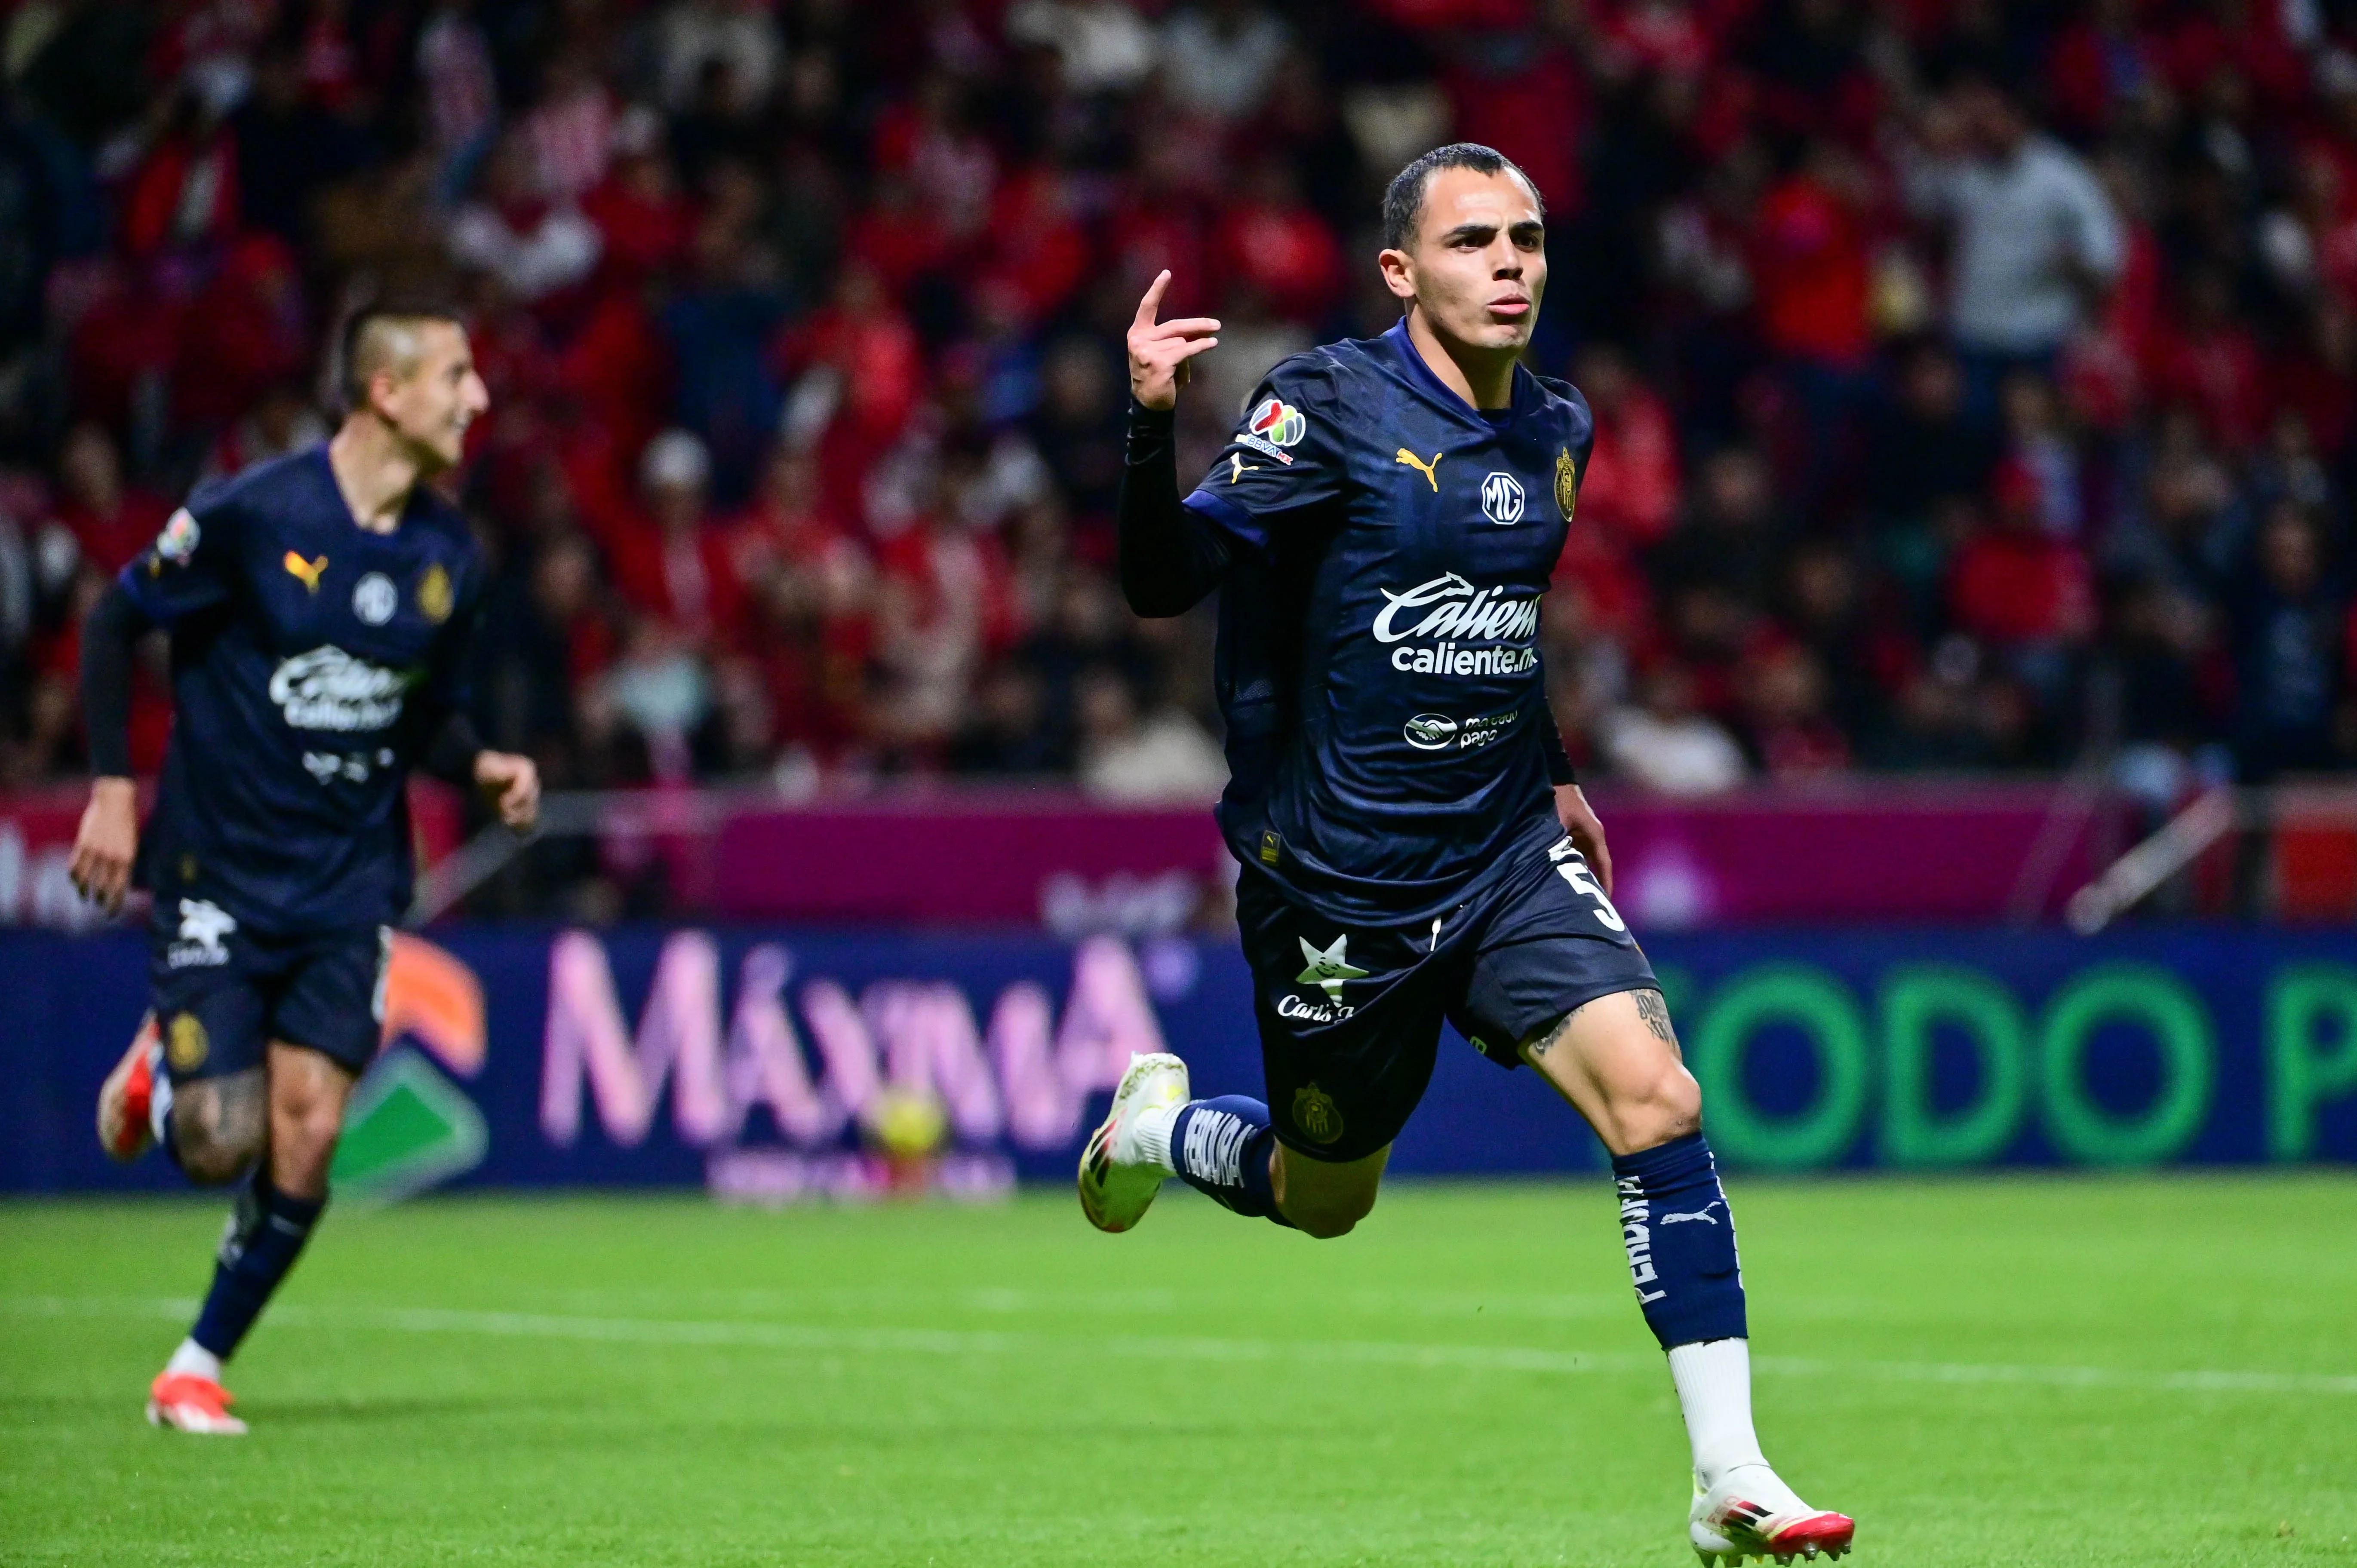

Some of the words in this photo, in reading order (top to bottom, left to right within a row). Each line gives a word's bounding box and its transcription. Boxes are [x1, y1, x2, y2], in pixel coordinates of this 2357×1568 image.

[1248, 437, 1276, 457] BBVA
[1278, 452, 1292, 465] MX
[1485, 476, 1521, 522] MG
[1278, 994, 1333, 1022] Carl's
[1656, 961, 2217, 1167] ODO
